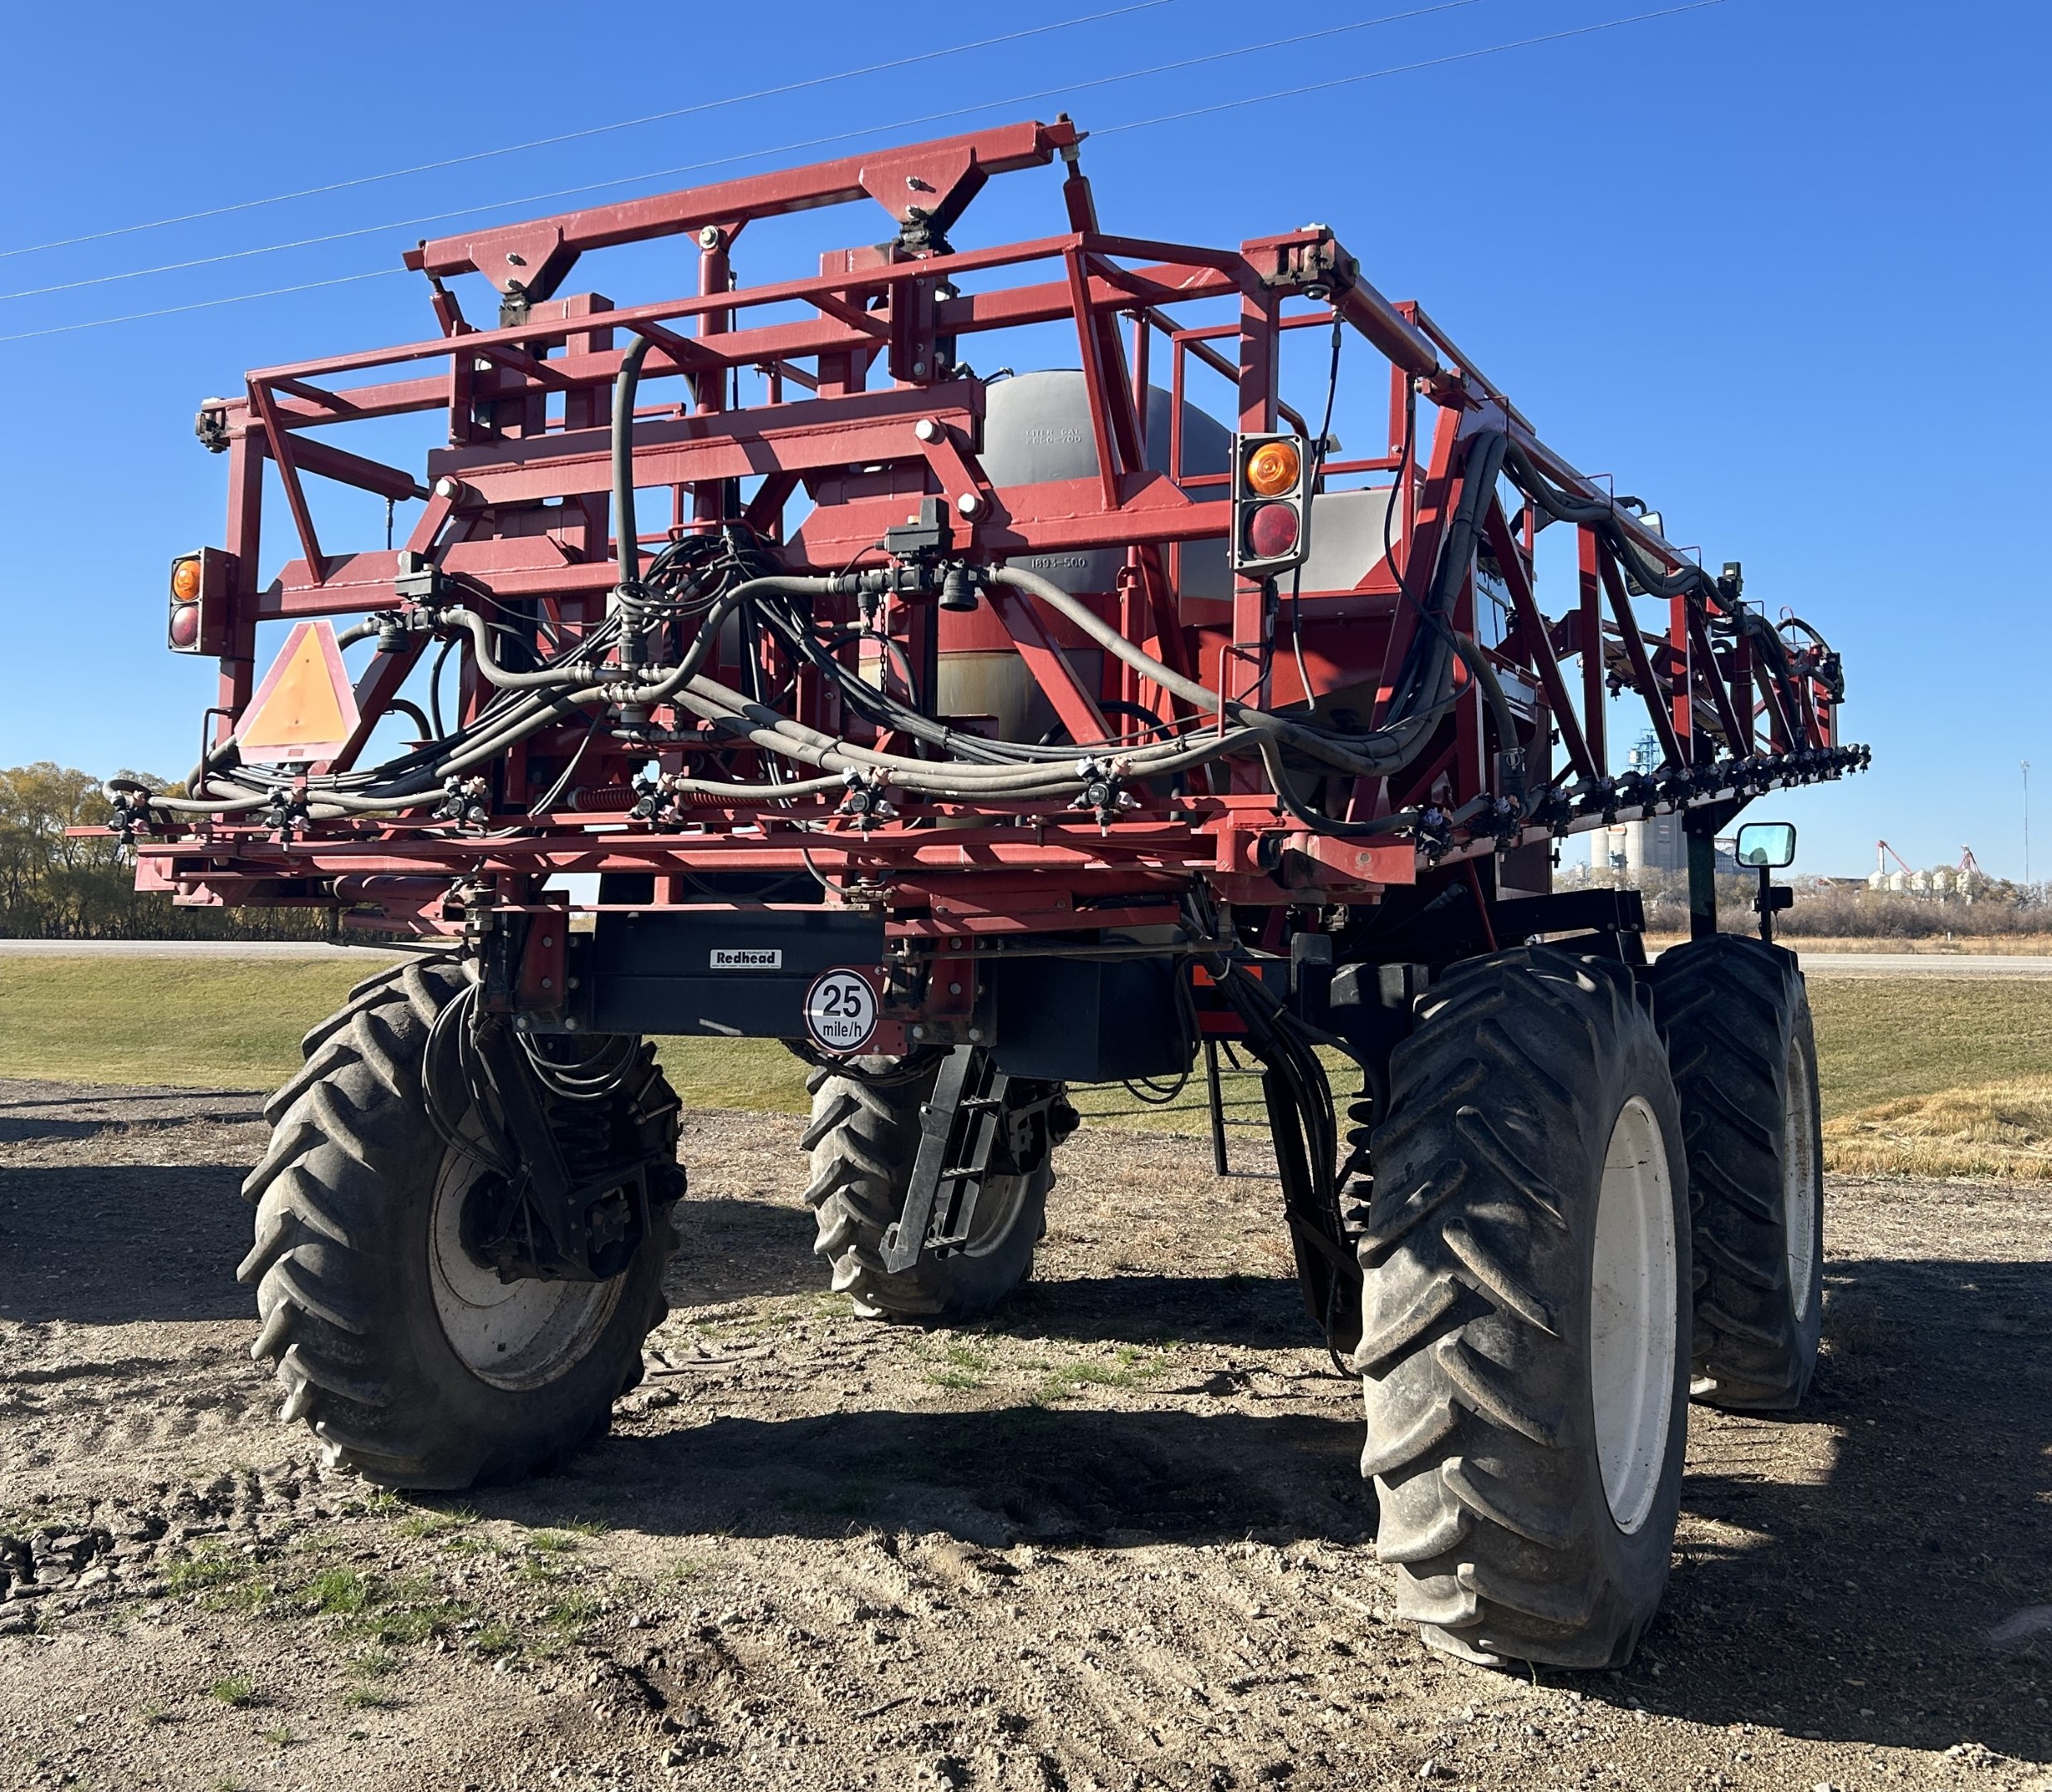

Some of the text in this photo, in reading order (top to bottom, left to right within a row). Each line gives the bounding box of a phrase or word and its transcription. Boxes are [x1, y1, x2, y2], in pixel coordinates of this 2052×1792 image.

[1031, 557, 1086, 568] 1893-500
[716, 951, 776, 964] Redhead
[823, 984, 861, 1018] 25
[823, 1020, 862, 1037] mile/h
